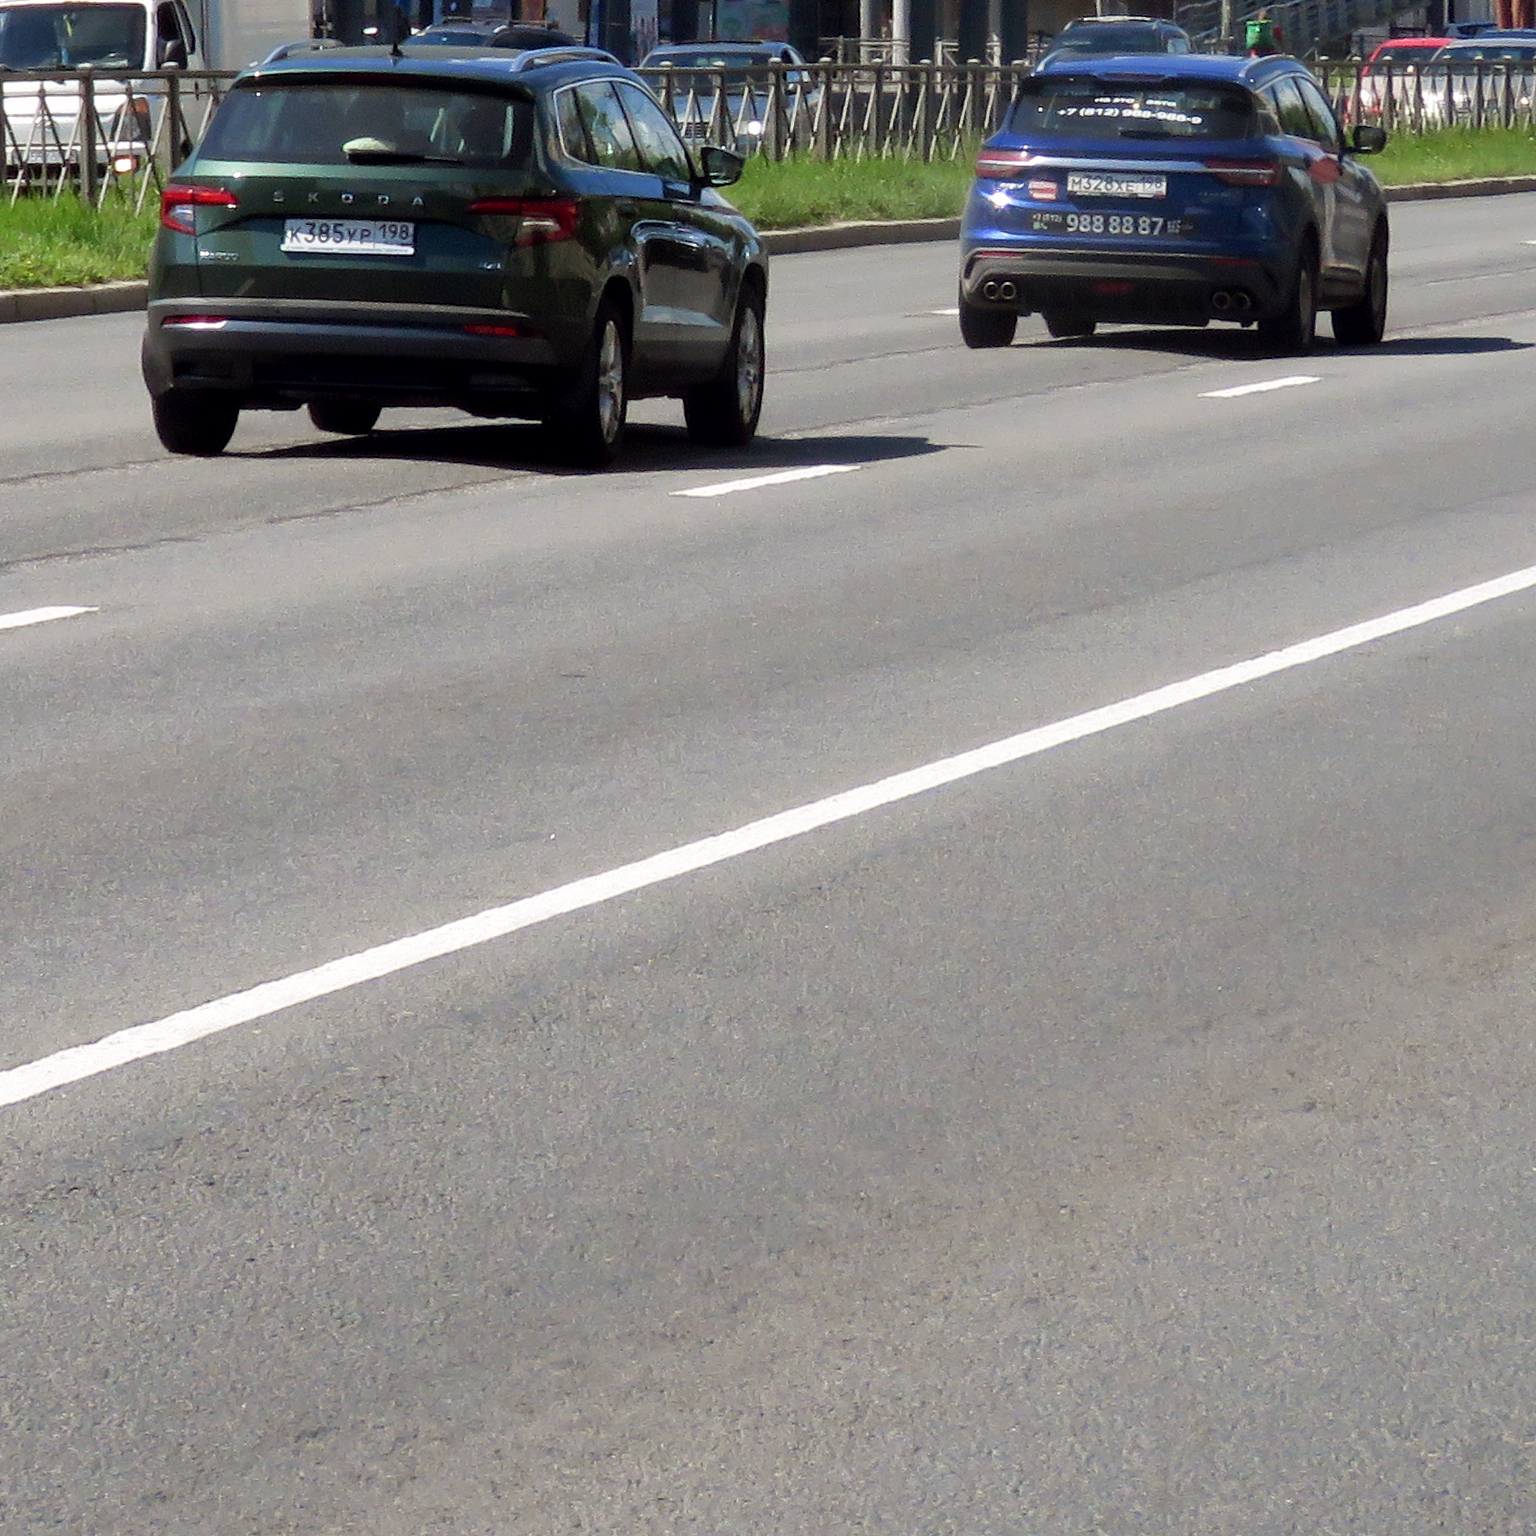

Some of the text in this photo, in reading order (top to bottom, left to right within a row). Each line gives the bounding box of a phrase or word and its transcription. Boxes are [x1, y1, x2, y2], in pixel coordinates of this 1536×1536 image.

[1057, 107, 1078, 116] +7
[1079, 107, 1120, 117] (812)
[1071, 175, 1136, 192] М328ХЕ
[289, 222, 411, 245] К385УР 198
[1066, 213, 1105, 233] 988
[1108, 215, 1135, 234] 88
[1137, 216, 1164, 236] 87
